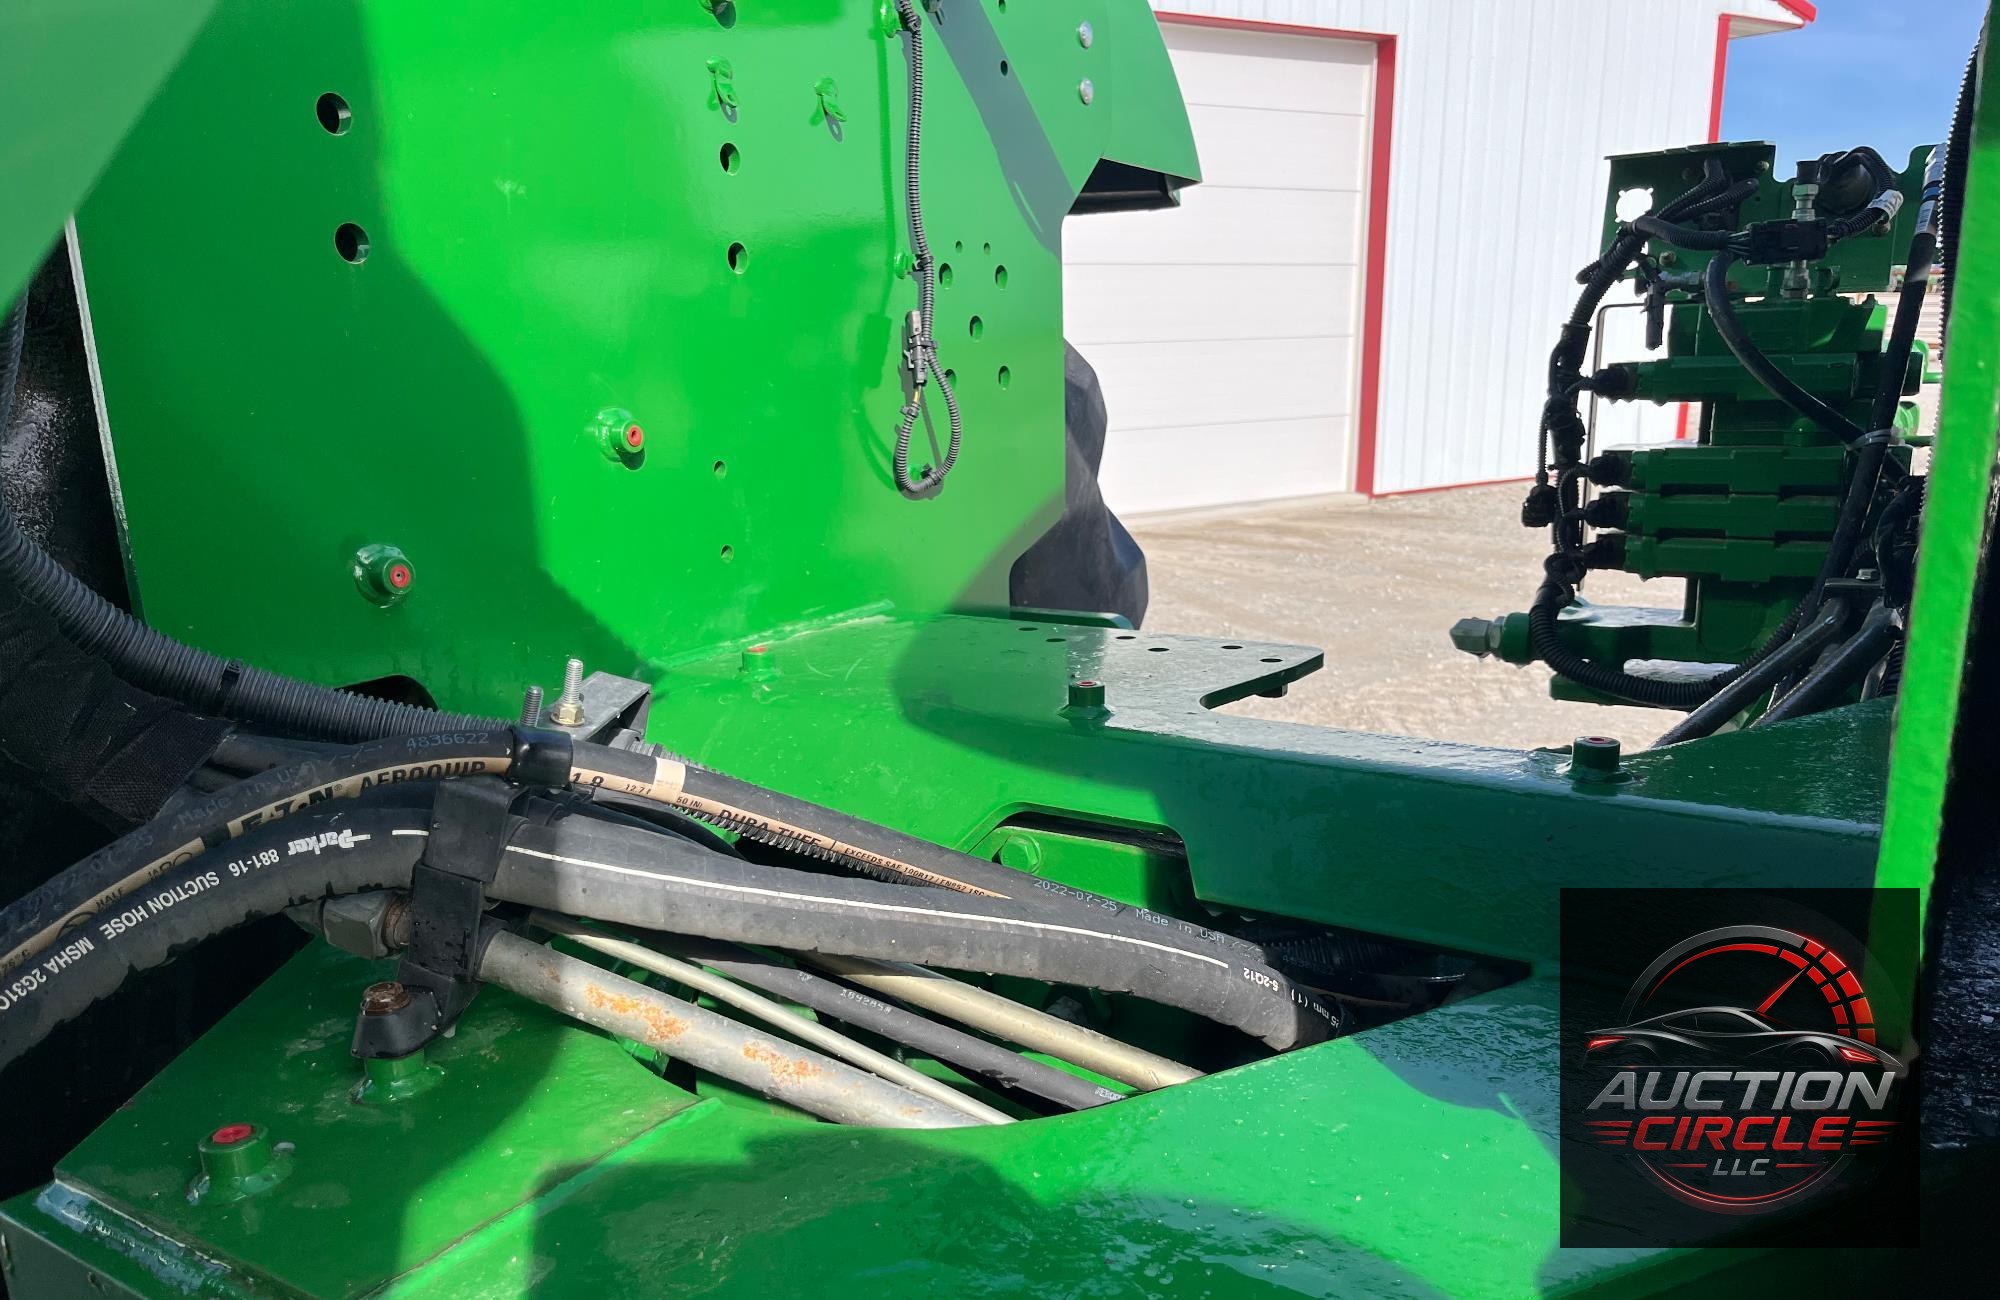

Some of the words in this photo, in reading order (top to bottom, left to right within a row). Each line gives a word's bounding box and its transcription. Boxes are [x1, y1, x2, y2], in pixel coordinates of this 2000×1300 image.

[406, 733, 489, 749] 4836622
[287, 829, 371, 856] Parker
[228, 849, 280, 877] 881-16
[147, 870, 221, 916] SUCTION
[99, 905, 149, 940] HOSE
[1032, 878, 1117, 911] 2022-07-25
[1136, 908, 1169, 926] Made
[1200, 928, 1225, 944] USA
[43, 936, 95, 975] MSHA
